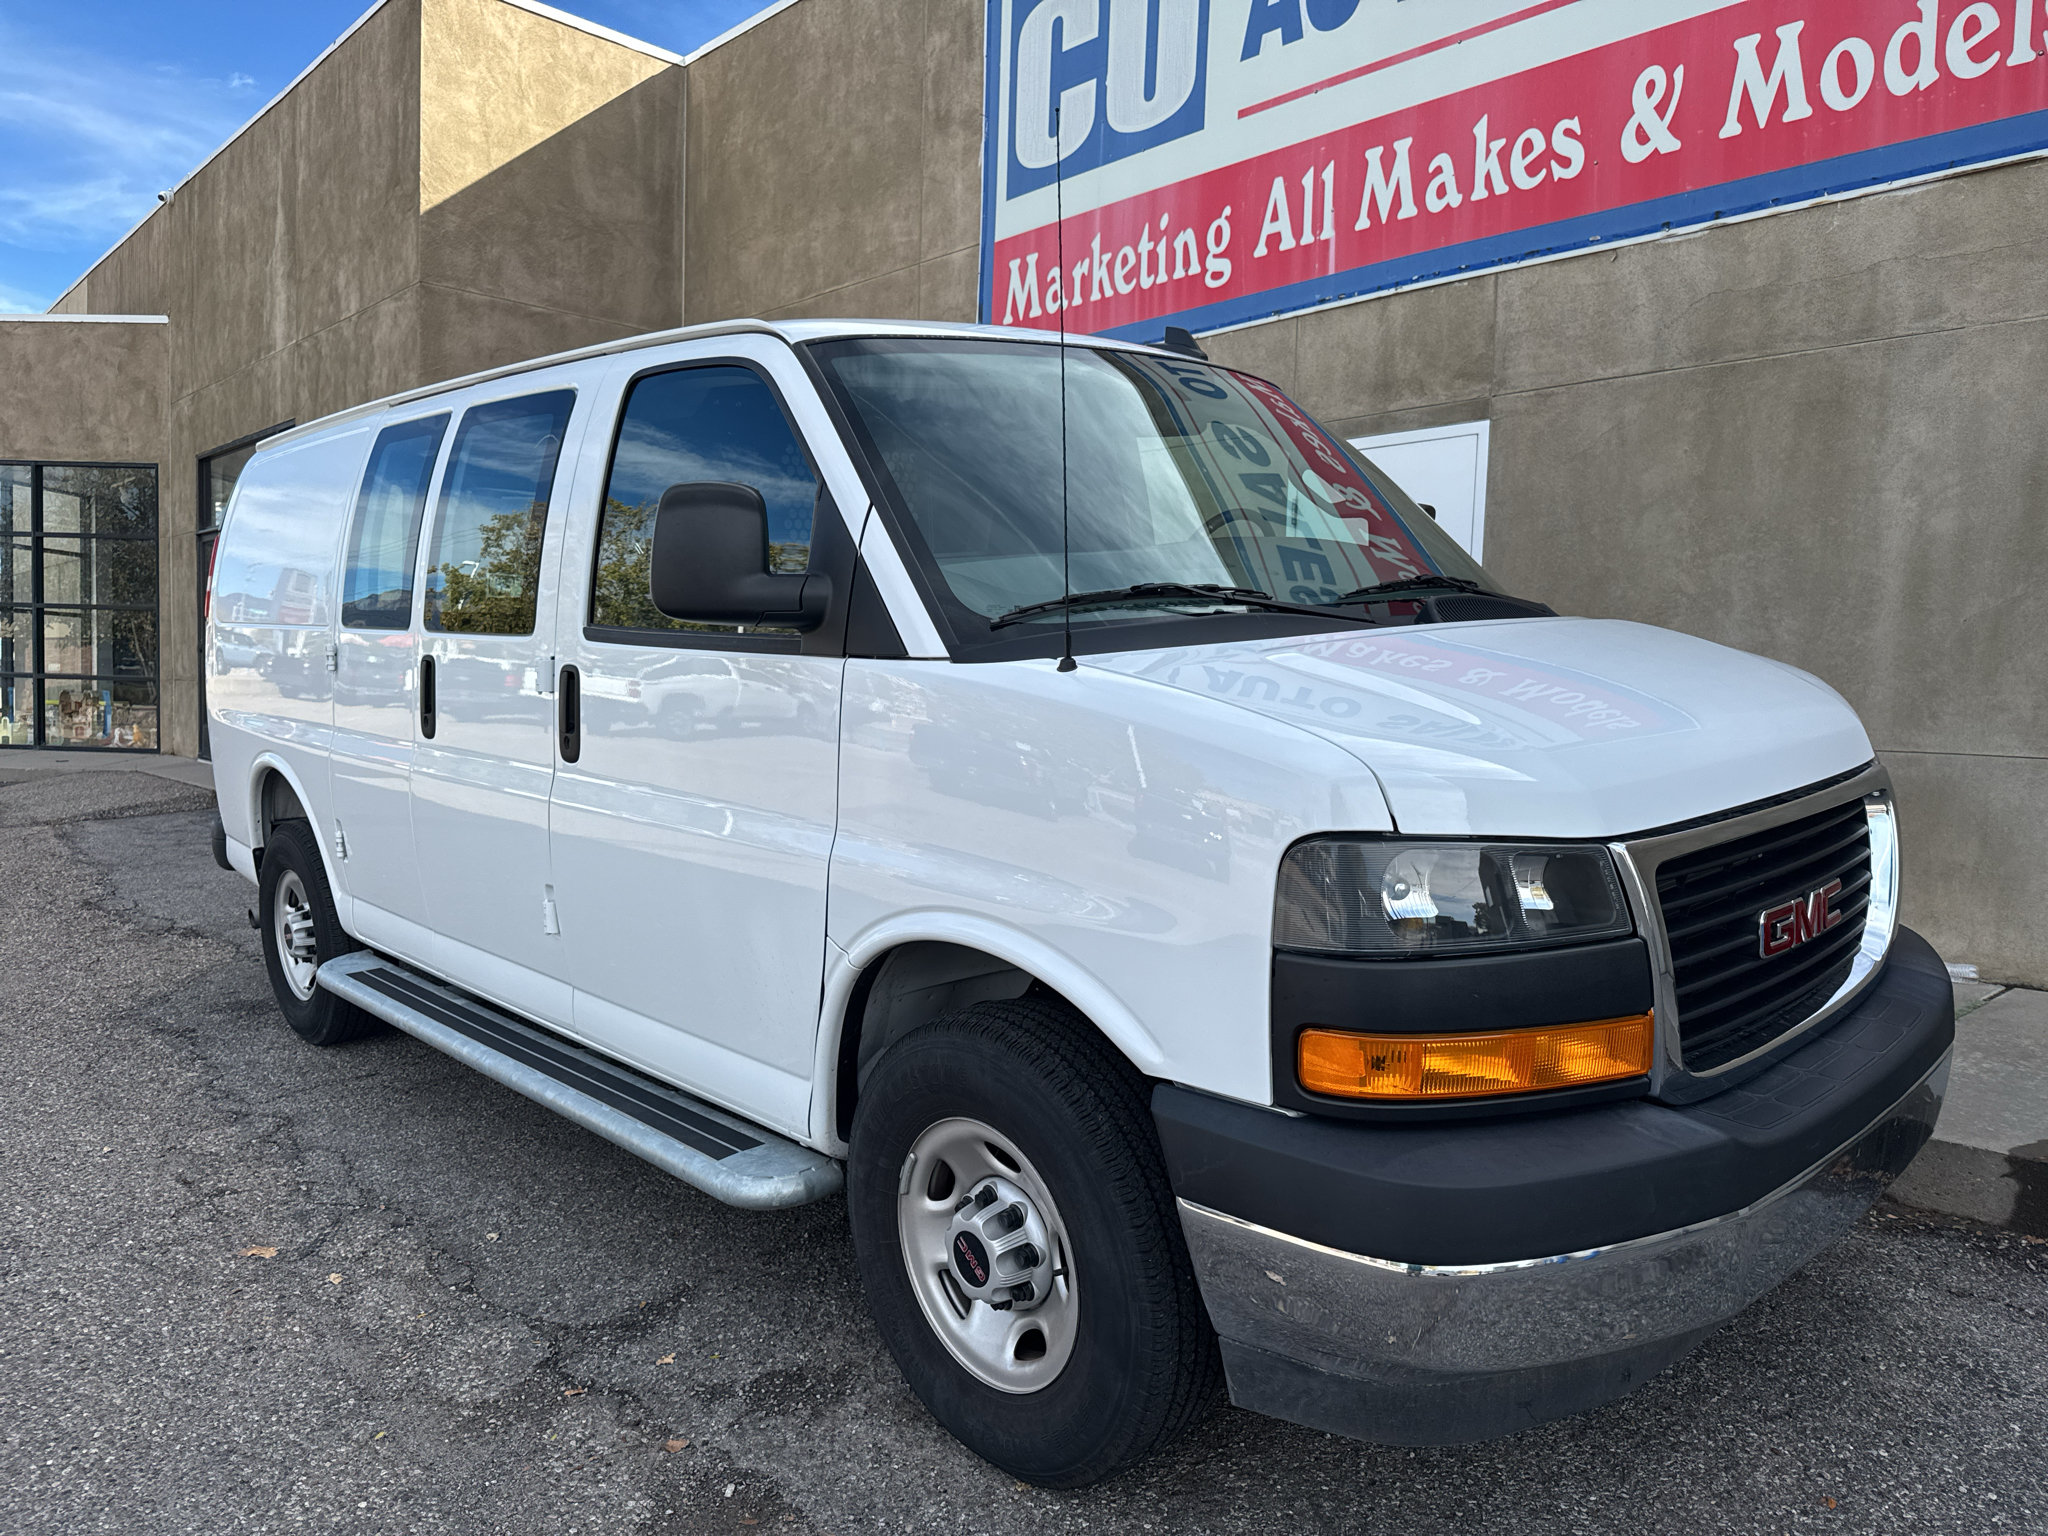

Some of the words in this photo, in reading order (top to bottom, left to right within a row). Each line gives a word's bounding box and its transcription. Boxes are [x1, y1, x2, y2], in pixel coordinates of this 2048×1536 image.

[1015, 0, 1198, 169] CU
[1003, 205, 1232, 325] Marketing
[1253, 160, 1336, 259] All
[1354, 113, 1585, 233] Makes
[1620, 64, 1684, 164] &
[1718, 0, 2048, 139] Model
[1759, 877, 1843, 959] GMC
[956, 1235, 987, 1283] GMC
